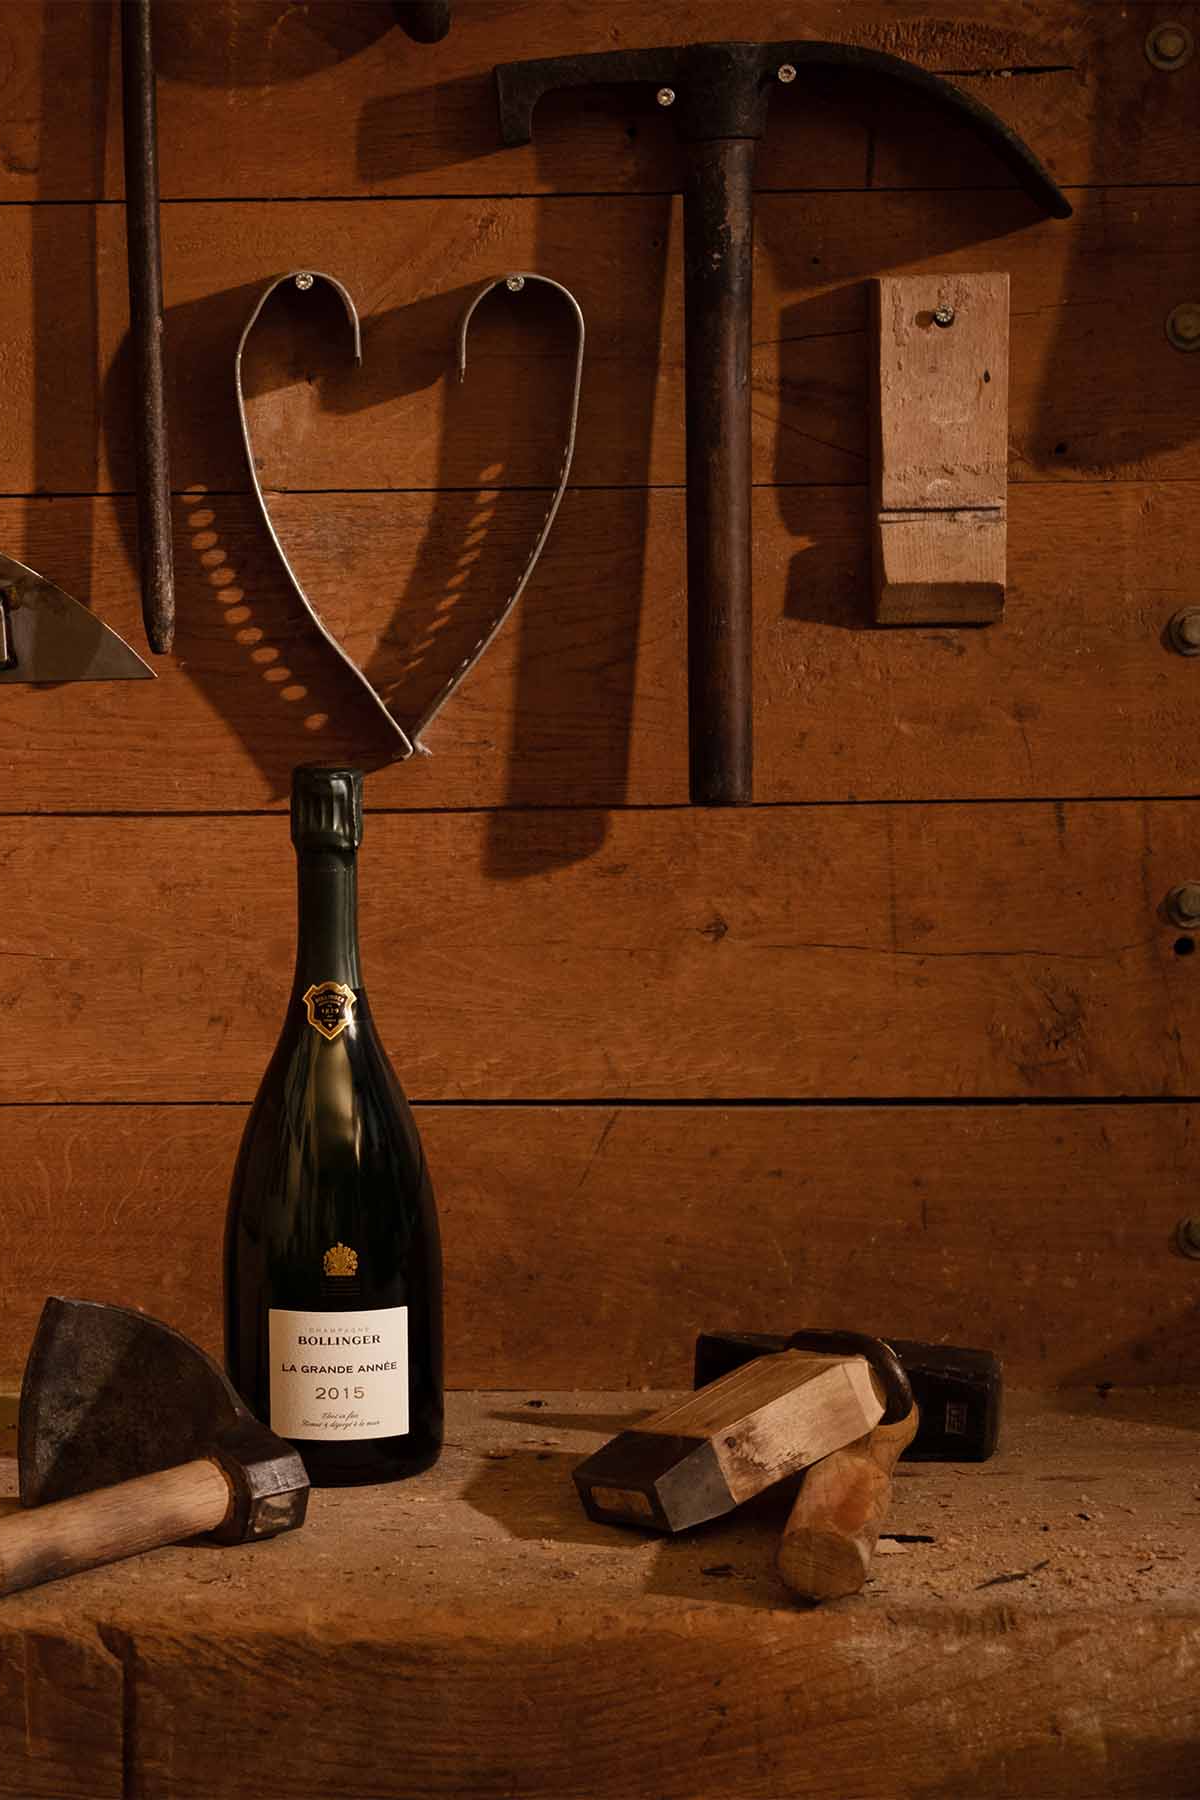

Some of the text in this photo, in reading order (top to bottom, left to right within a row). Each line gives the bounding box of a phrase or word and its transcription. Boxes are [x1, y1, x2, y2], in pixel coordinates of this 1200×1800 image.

[298, 1334, 381, 1346] BOLLINGER
[281, 1361, 398, 1374] LA GRANDE ANNÉE
[315, 1386, 365, 1400] 2015
